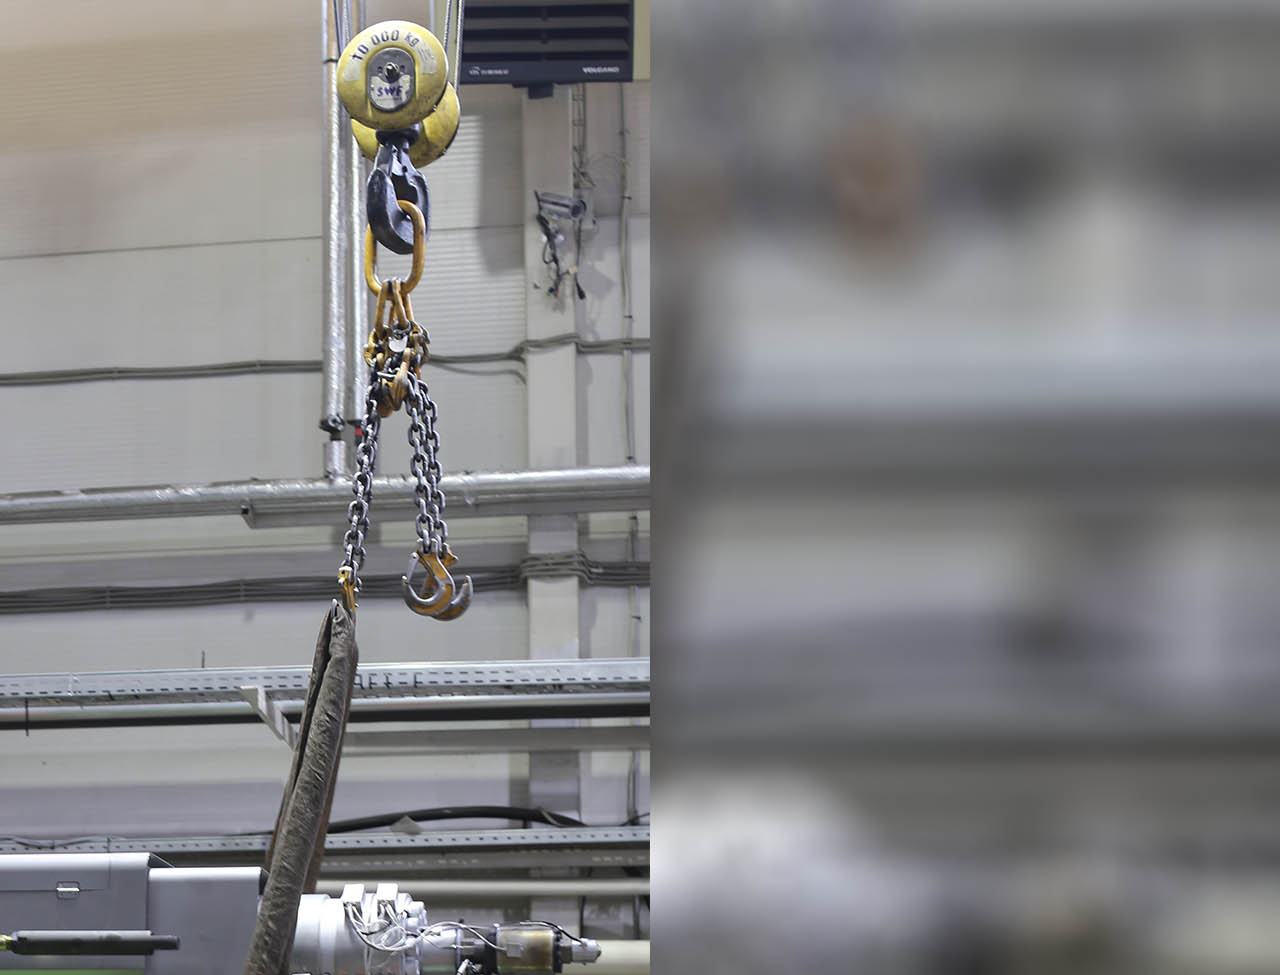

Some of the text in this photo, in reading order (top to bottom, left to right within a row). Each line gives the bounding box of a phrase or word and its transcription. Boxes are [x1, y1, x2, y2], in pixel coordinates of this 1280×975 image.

[352, 29, 420, 60] 10 000 kg
[377, 85, 403, 97] SWF
